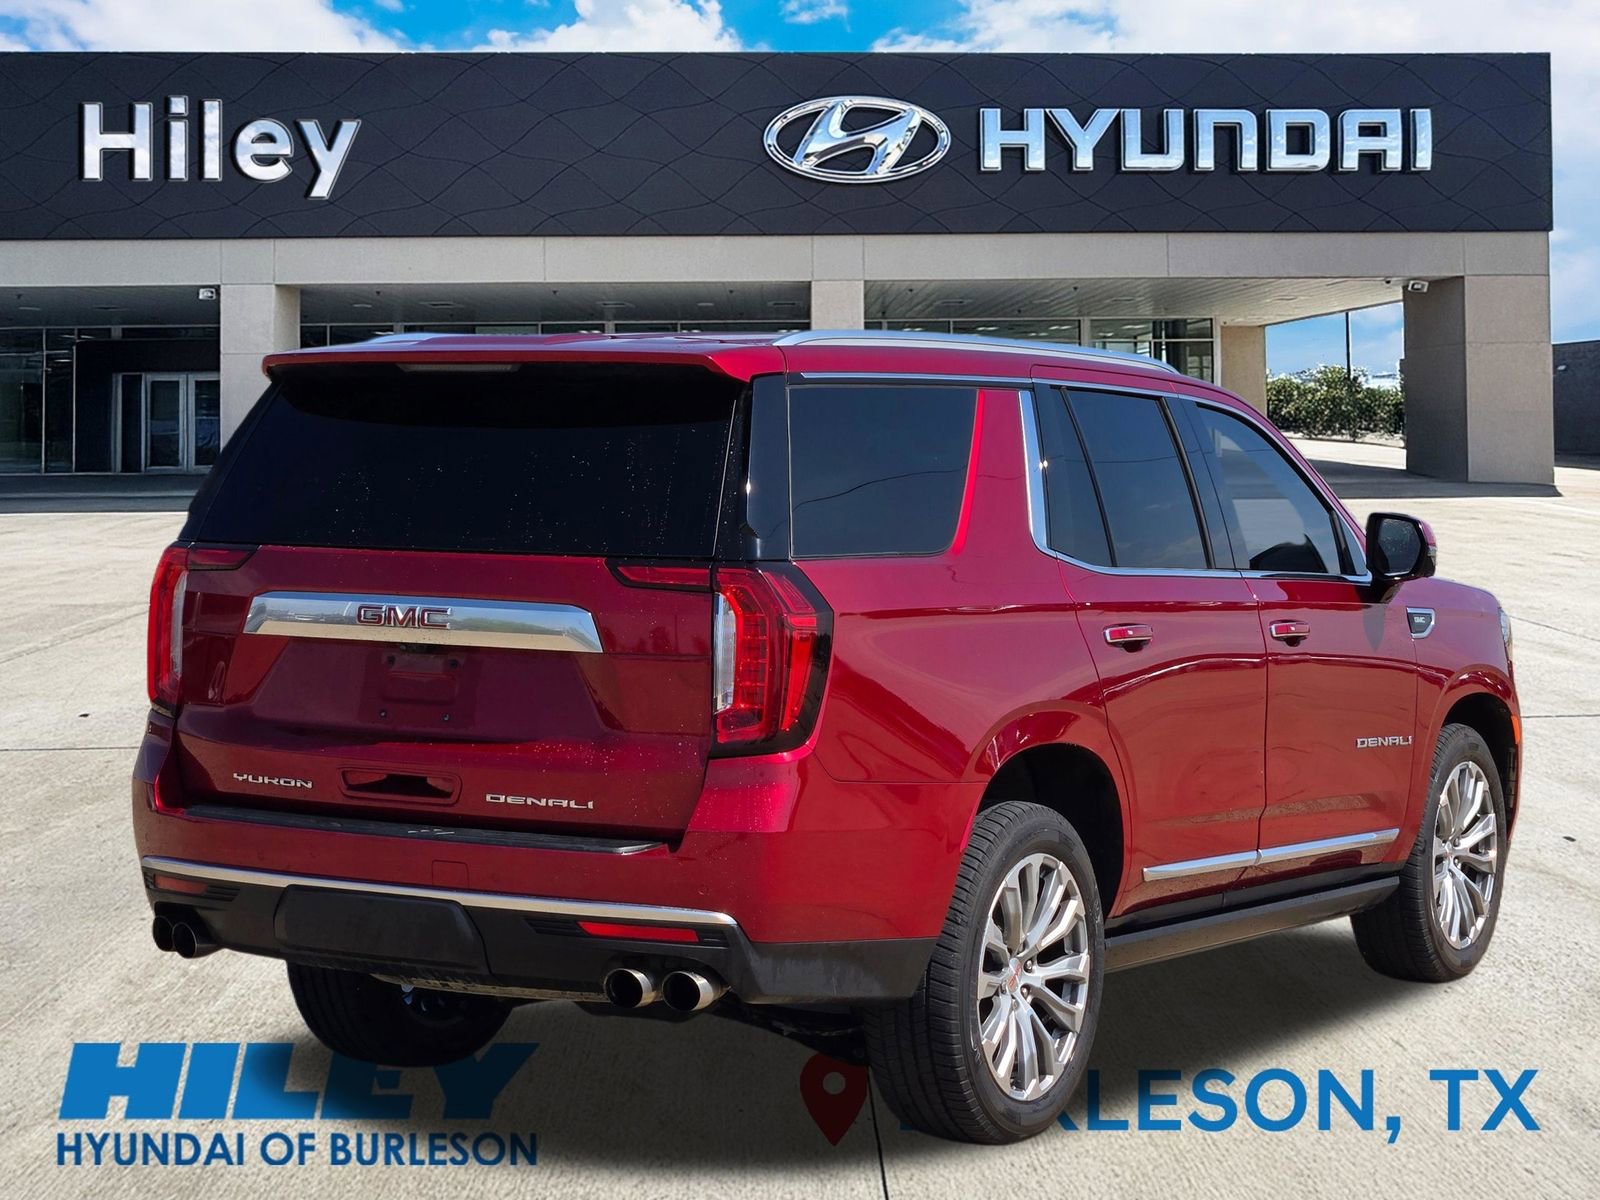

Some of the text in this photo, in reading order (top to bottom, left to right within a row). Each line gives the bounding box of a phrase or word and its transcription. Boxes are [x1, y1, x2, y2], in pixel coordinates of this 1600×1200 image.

[79, 95, 362, 200] Hiley
[979, 107, 1432, 172] HYUNDAI
[356, 603, 452, 630] GMC
[1356, 735, 1413, 749] DENALI
[232, 772, 314, 790] YUKON
[485, 793, 595, 810] DENALI
